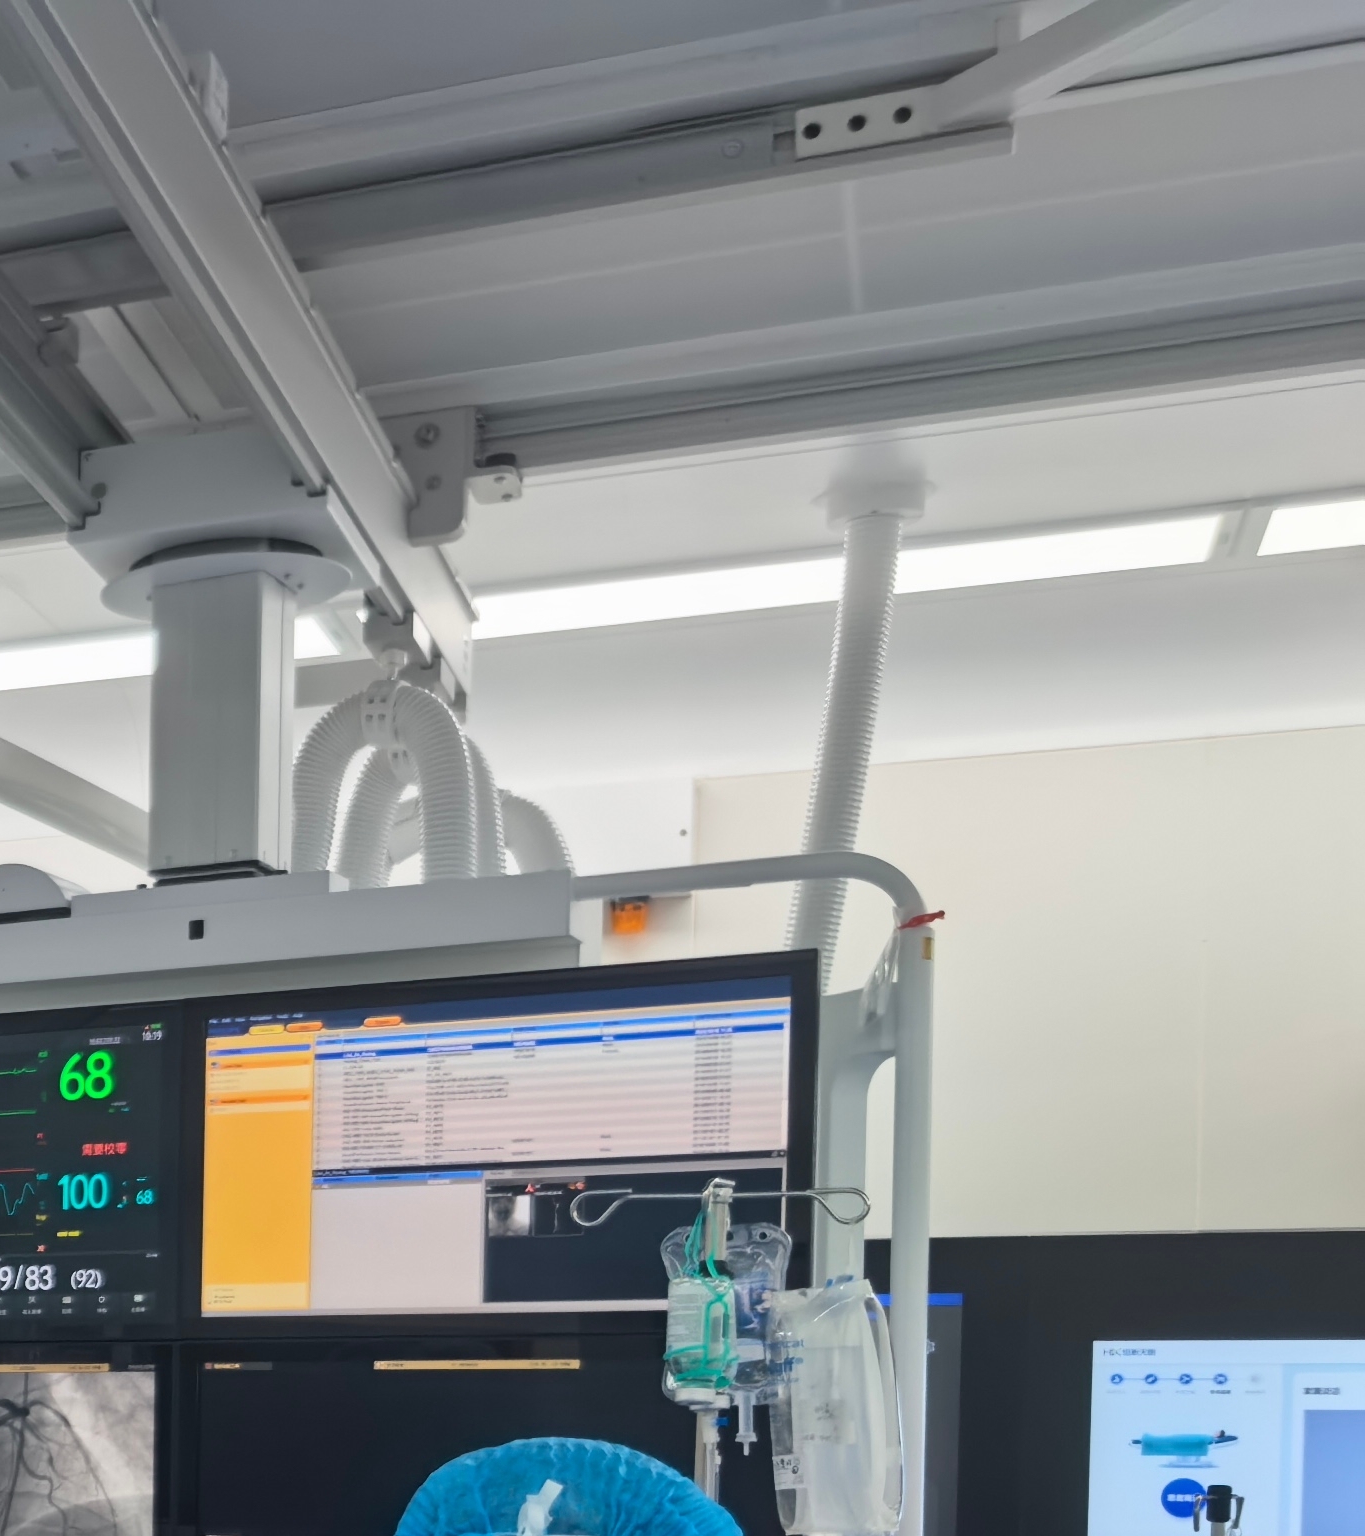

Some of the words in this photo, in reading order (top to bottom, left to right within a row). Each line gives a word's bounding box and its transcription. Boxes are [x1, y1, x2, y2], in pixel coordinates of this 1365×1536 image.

[60, 1051, 113, 1100] 68
[57, 1173, 108, 1210] 100
[136, 1189, 153, 1205] 68
[70, 1269, 102, 1290] (92)
